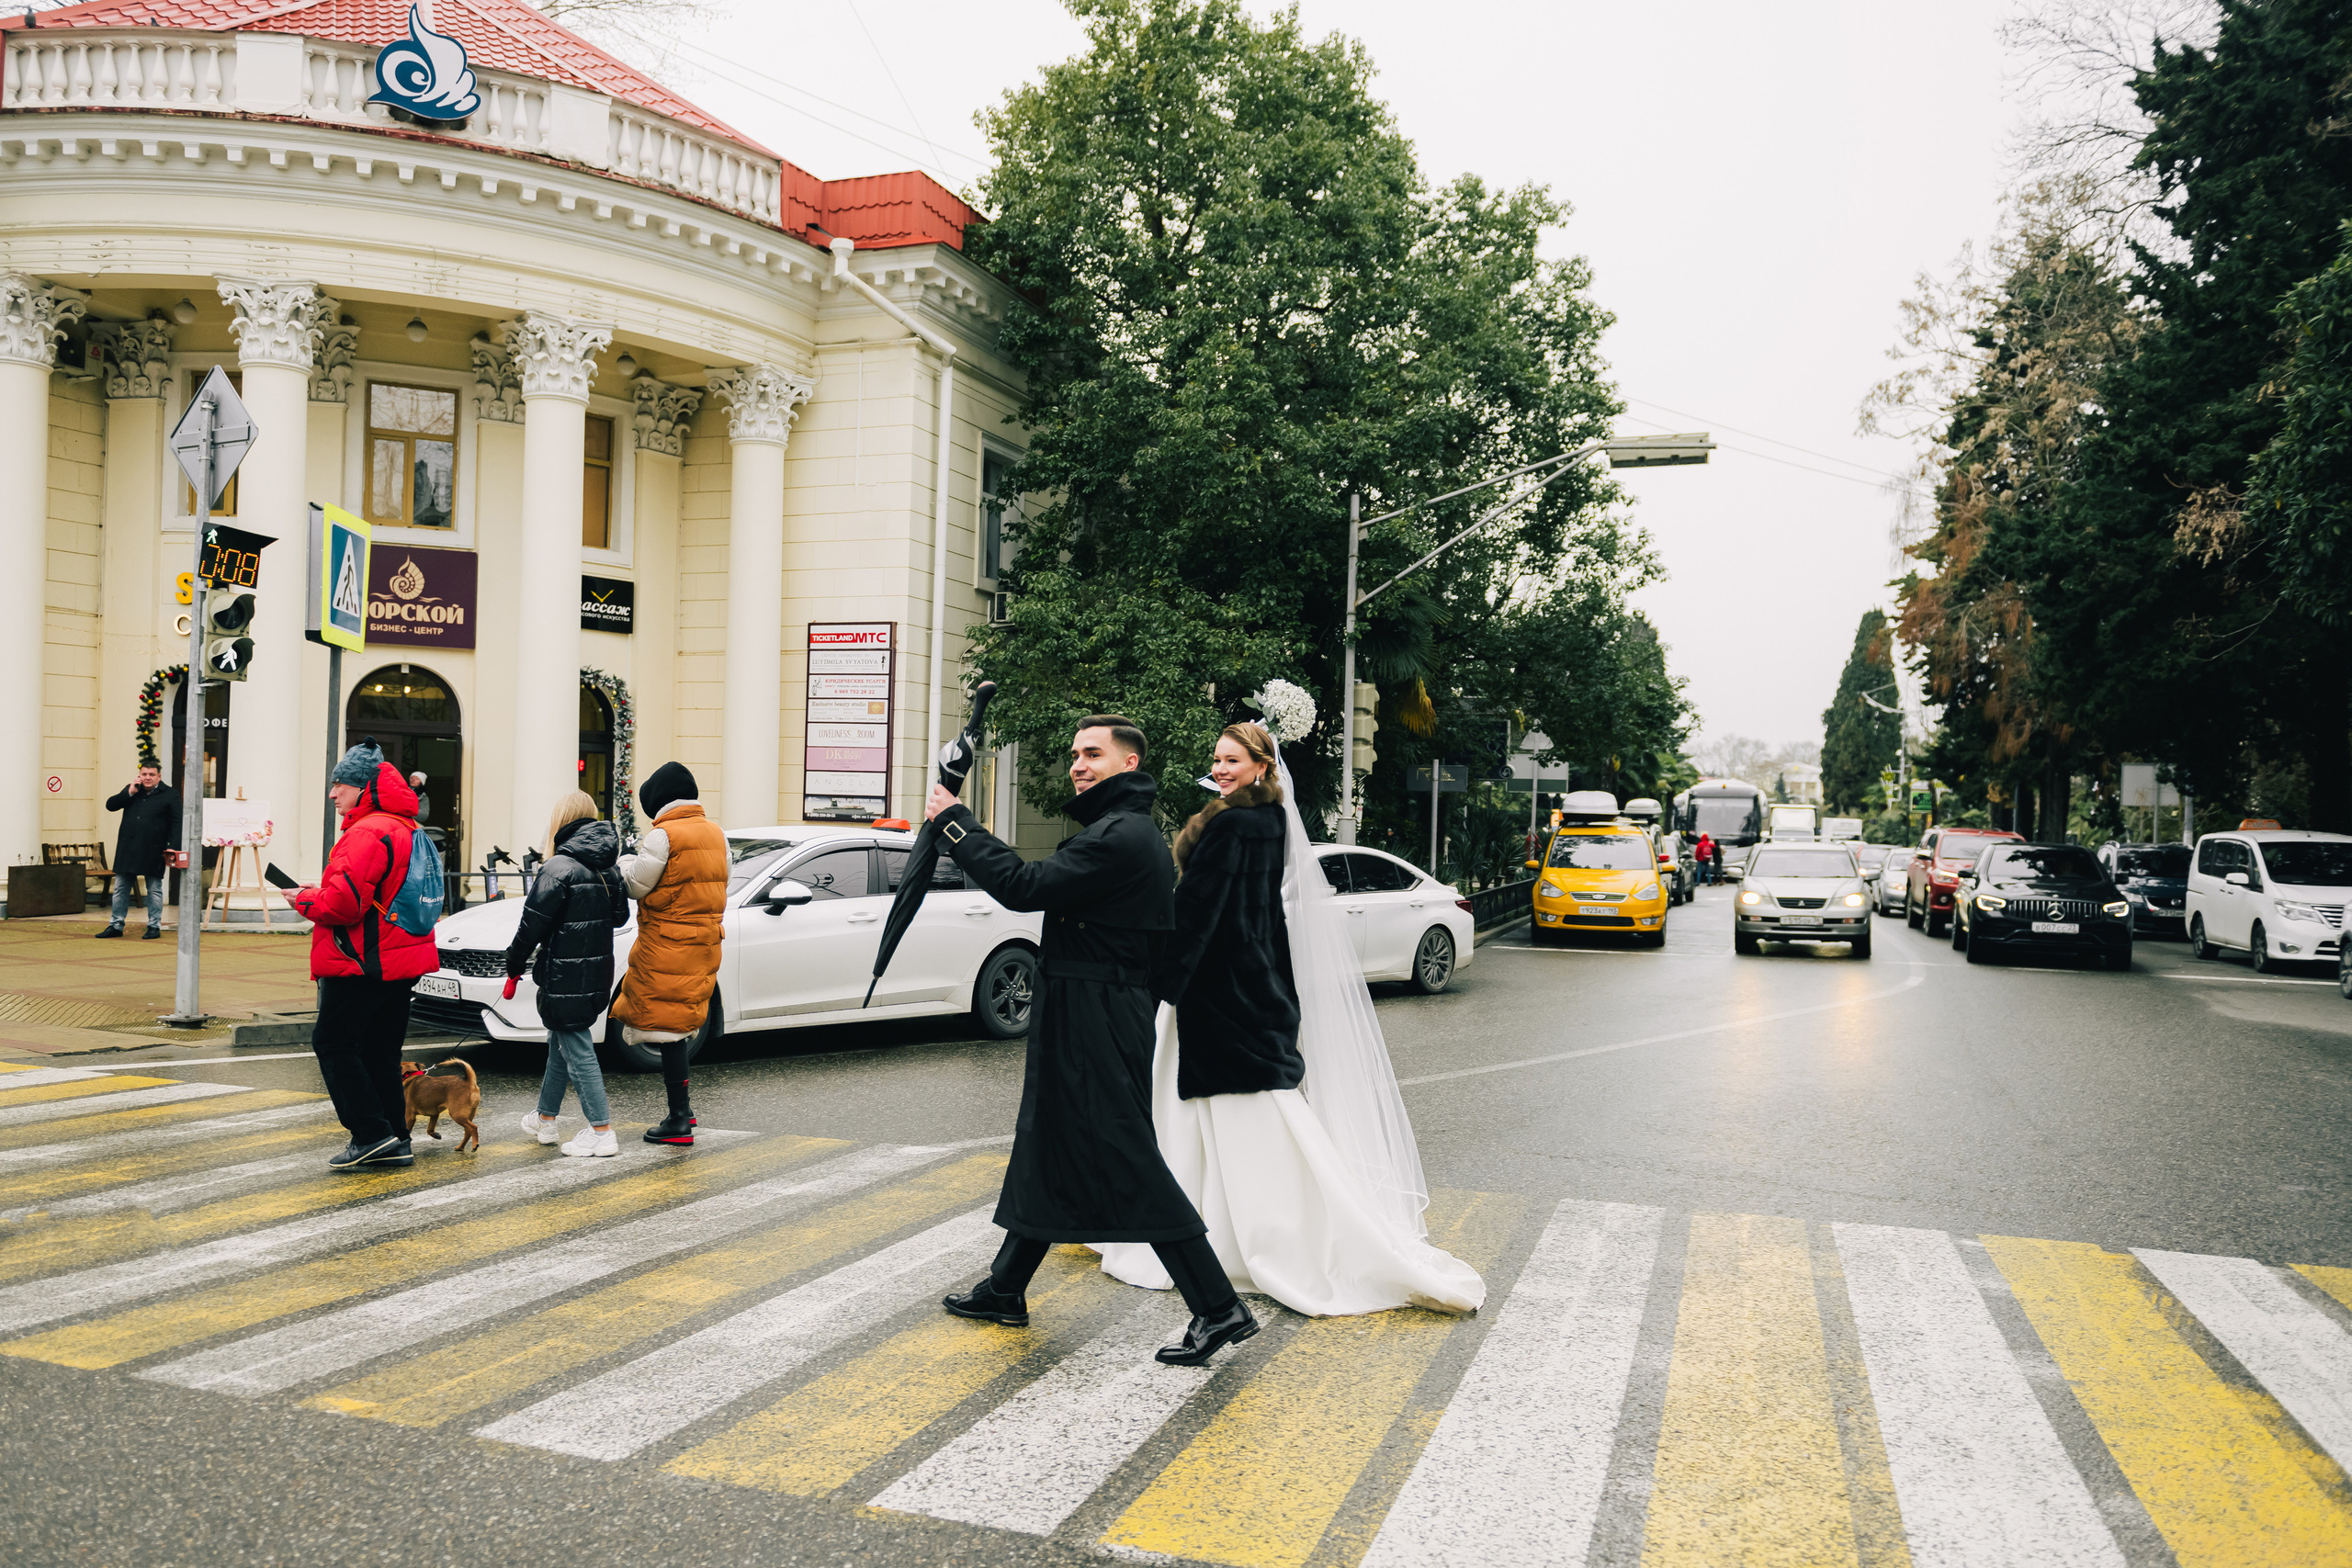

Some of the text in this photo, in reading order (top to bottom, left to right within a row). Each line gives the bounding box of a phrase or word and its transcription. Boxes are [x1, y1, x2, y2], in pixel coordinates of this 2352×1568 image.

[366, 600, 464, 625] ОРСКОЙ
[581, 601, 631, 615] ассаж
[369, 623, 407, 633] БИЗНЕС
[413, 626, 444, 635] ЦЕНТР
[204, 717, 228, 728] ОФЕ
[819, 729, 876, 739] LOVELINESS ROOM
[826, 749, 843, 760] DK
